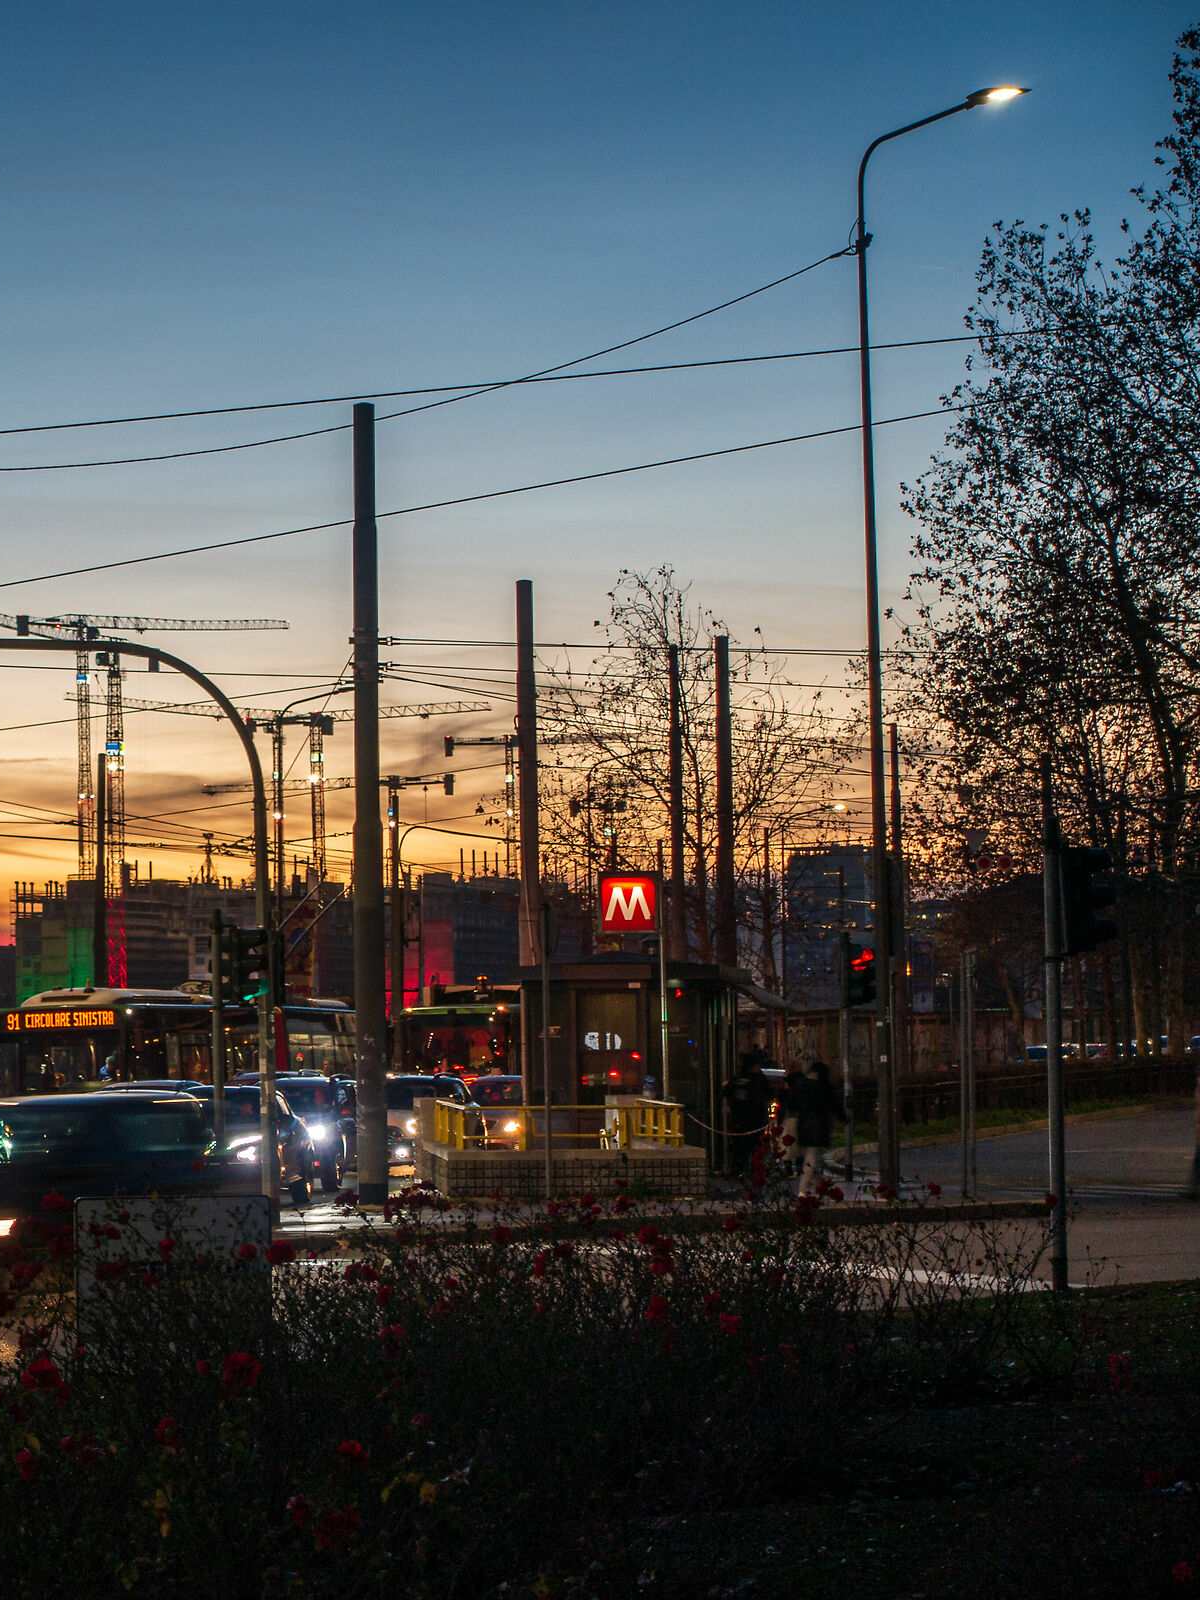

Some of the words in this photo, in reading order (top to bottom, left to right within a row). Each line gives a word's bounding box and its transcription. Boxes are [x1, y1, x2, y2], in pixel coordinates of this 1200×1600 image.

[605, 886, 652, 921] M
[7, 1013, 21, 1031] 91
[24, 1012, 71, 1029] CIRCOLARE
[73, 1010, 115, 1027] SINISTRA
